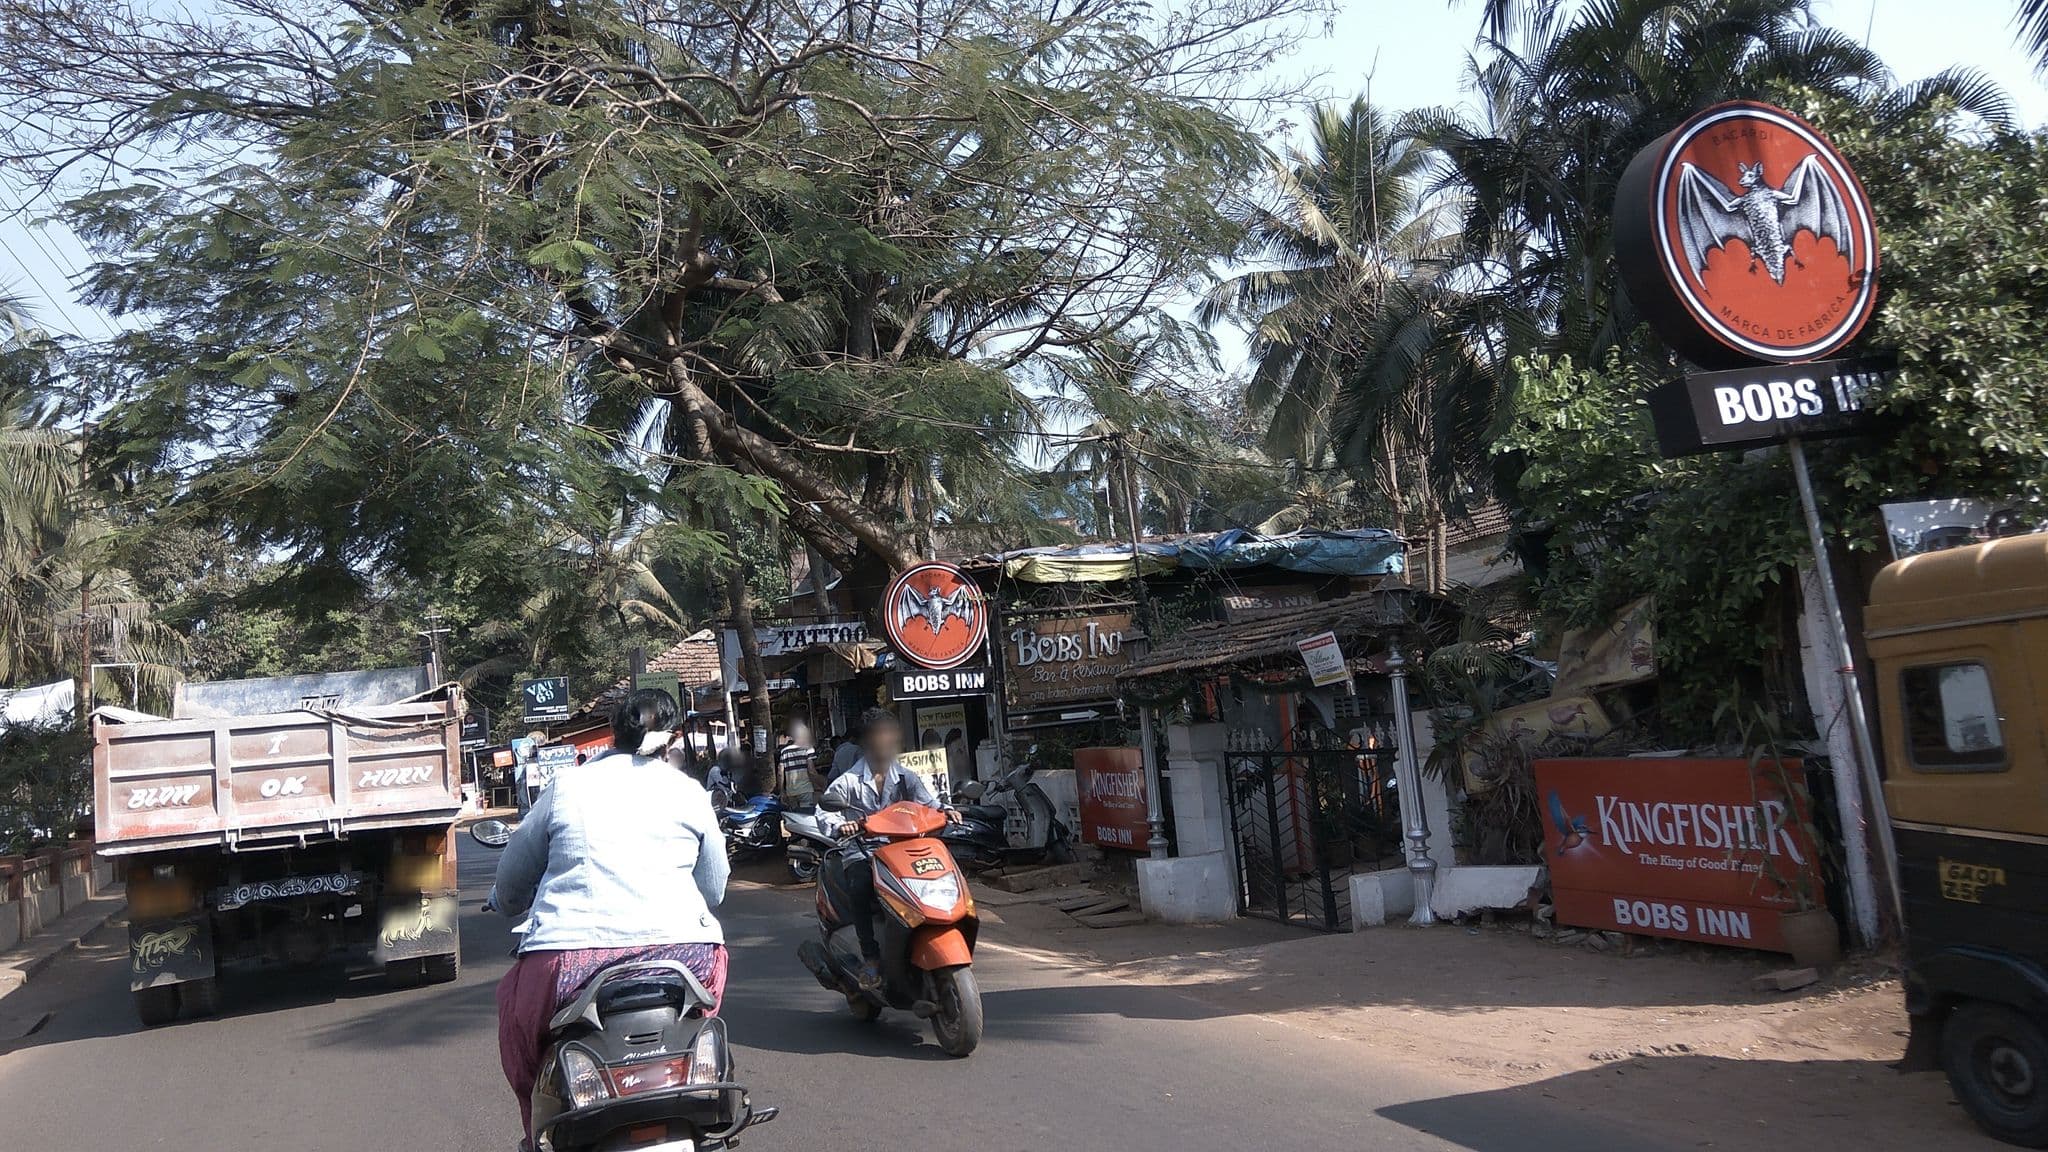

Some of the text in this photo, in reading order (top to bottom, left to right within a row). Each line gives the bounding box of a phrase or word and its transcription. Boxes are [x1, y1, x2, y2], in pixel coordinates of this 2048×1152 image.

[1720, 305, 1770, 338] MARCA
[1776, 329, 1795, 340] DE
[1714, 377, 1824, 425] BOBS
[778, 624, 868, 648] TATTOO
[526, 681, 553, 696] VAT
[903, 672, 985, 692] BOBS INN
[536, 690, 554, 703] 69
[268, 735, 288, 754] T
[260, 775, 307, 798] OK
[357, 765, 433, 788] HORN
[1090, 769, 1145, 804] KINGFISHER
[127, 784, 200, 809] BLOW
[1096, 826, 1133, 845] BOBS INN
[1595, 796, 1807, 865] KINGFISHER
[1640, 853, 1657, 865] The
[1660, 856, 1684, 869] King
[1686, 858, 1697, 868] of
[1699, 857, 1728, 870] Good
[1614, 899, 1752, 939] BOBS INN
